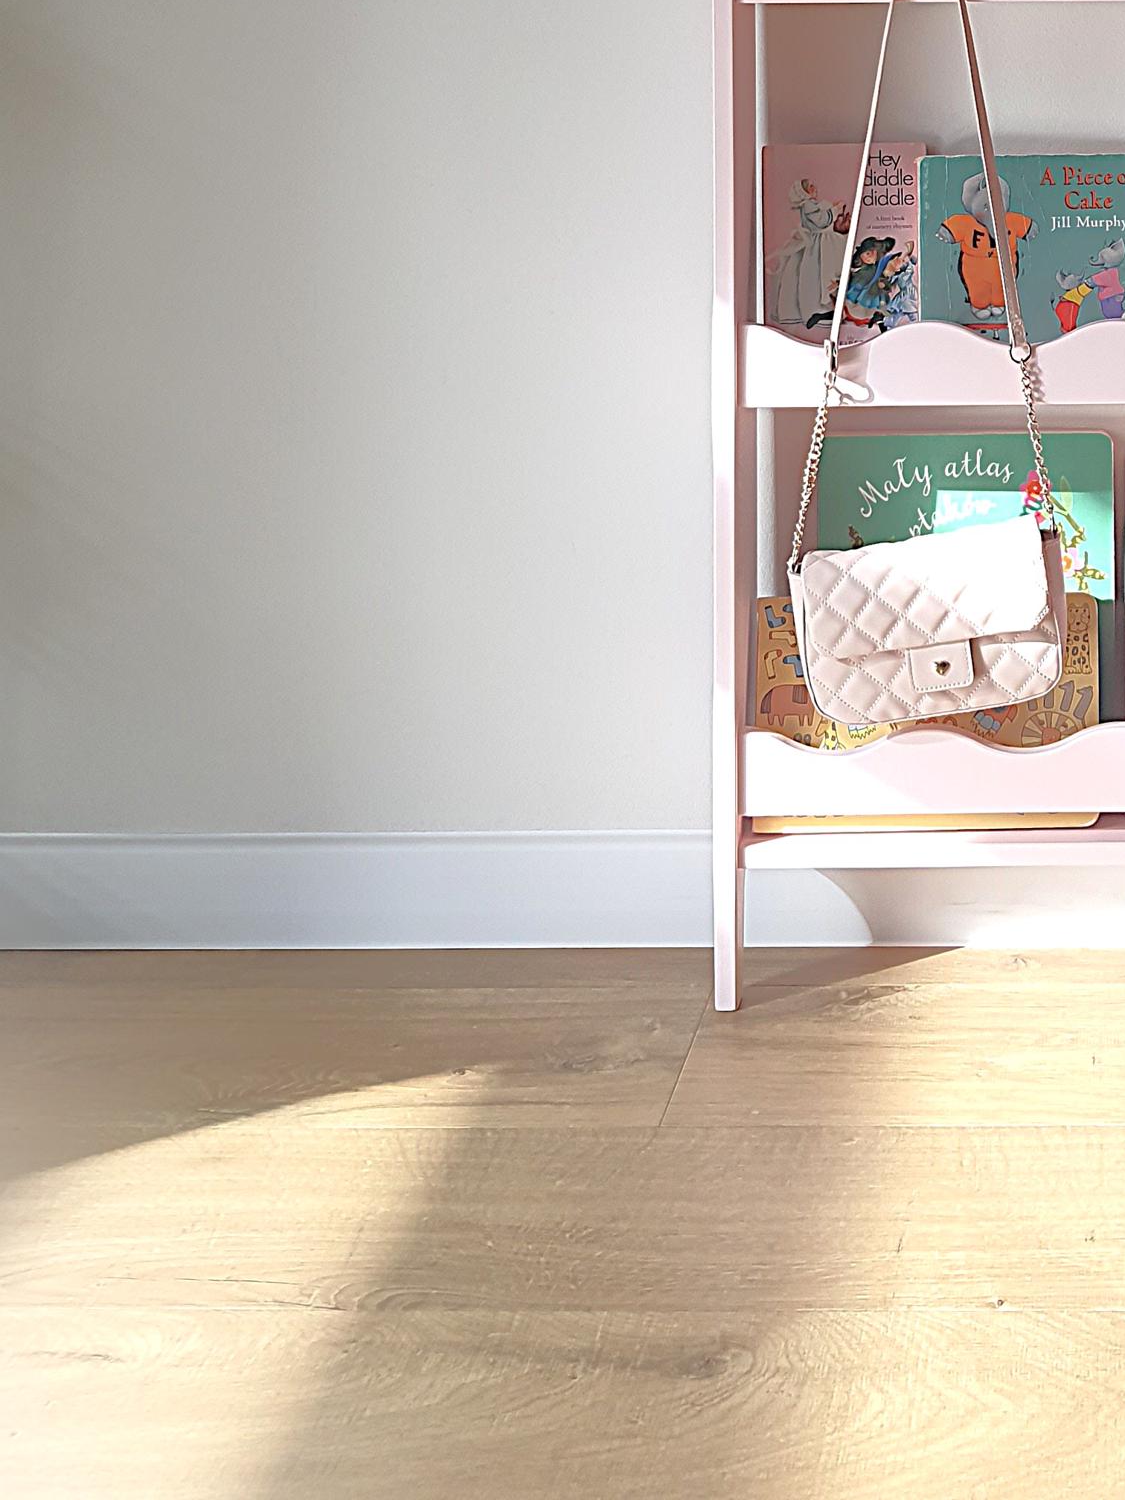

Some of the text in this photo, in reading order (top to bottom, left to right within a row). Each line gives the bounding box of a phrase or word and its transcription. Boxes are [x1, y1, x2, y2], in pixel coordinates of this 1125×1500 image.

[867, 149, 901, 171] Hey
[864, 168, 914, 187] diddle
[1039, 167, 1056, 186] A
[1062, 166, 1112, 186] Piece
[862, 188, 915, 206] diddle
[1064, 191, 1113, 210] Cake
[1051, 215, 1071, 232] Jill
[858, 448, 1014, 518] Mały atlas
